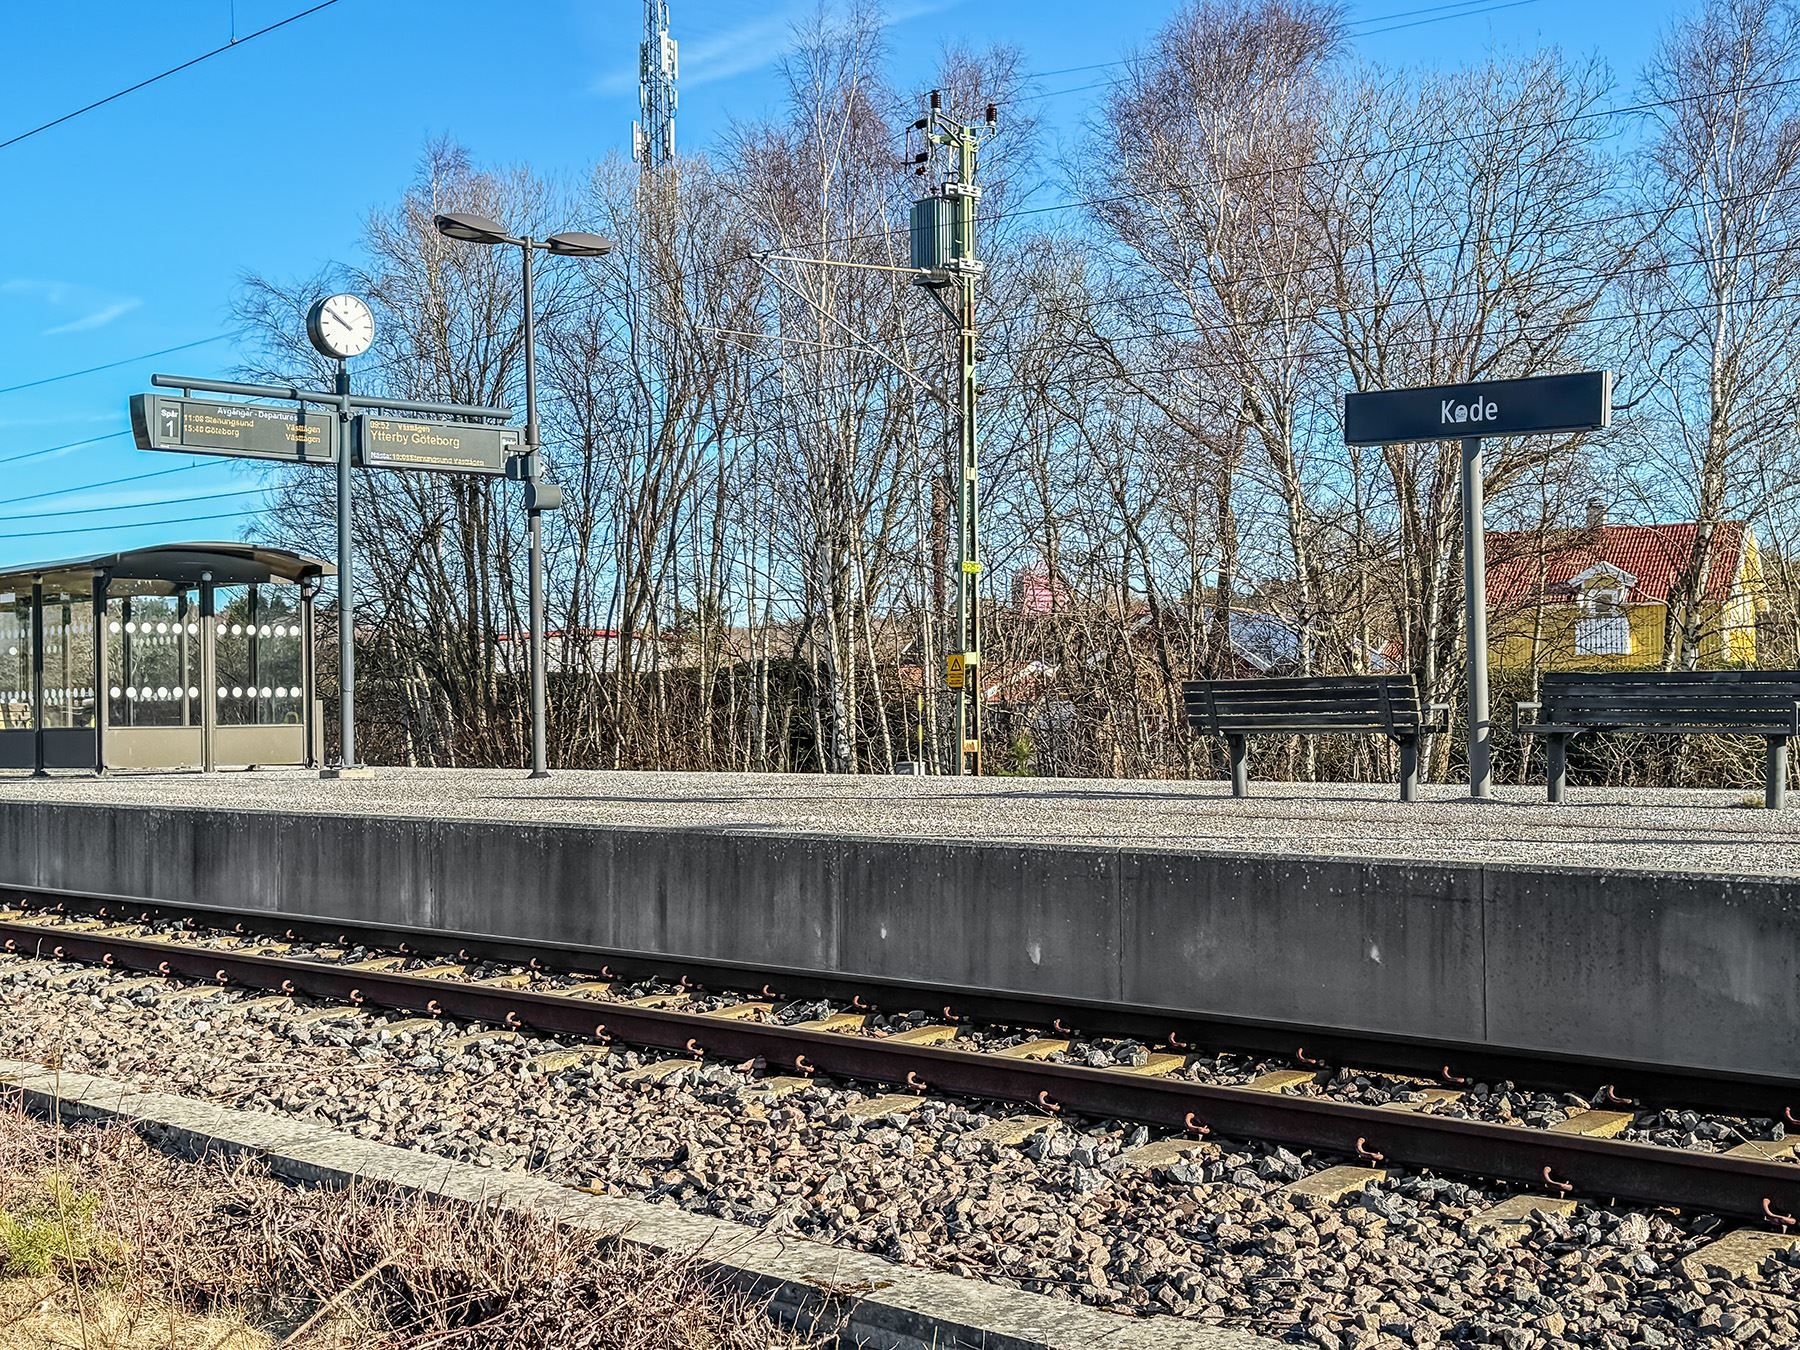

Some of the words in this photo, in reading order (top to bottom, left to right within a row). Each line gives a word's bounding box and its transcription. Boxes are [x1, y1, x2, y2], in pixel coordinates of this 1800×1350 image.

[160, 408, 179, 418] Spår
[217, 407, 253, 419] Avgångar
[258, 411, 298, 422] Departures
[1441, 395, 1498, 424] Kode
[166, 420, 174, 437] 1
[204, 416, 254, 427] Stenungsund
[205, 426, 240, 438] Göteborg
[370, 430, 409, 445] Ytterby
[411, 433, 460, 449] Göteborg
